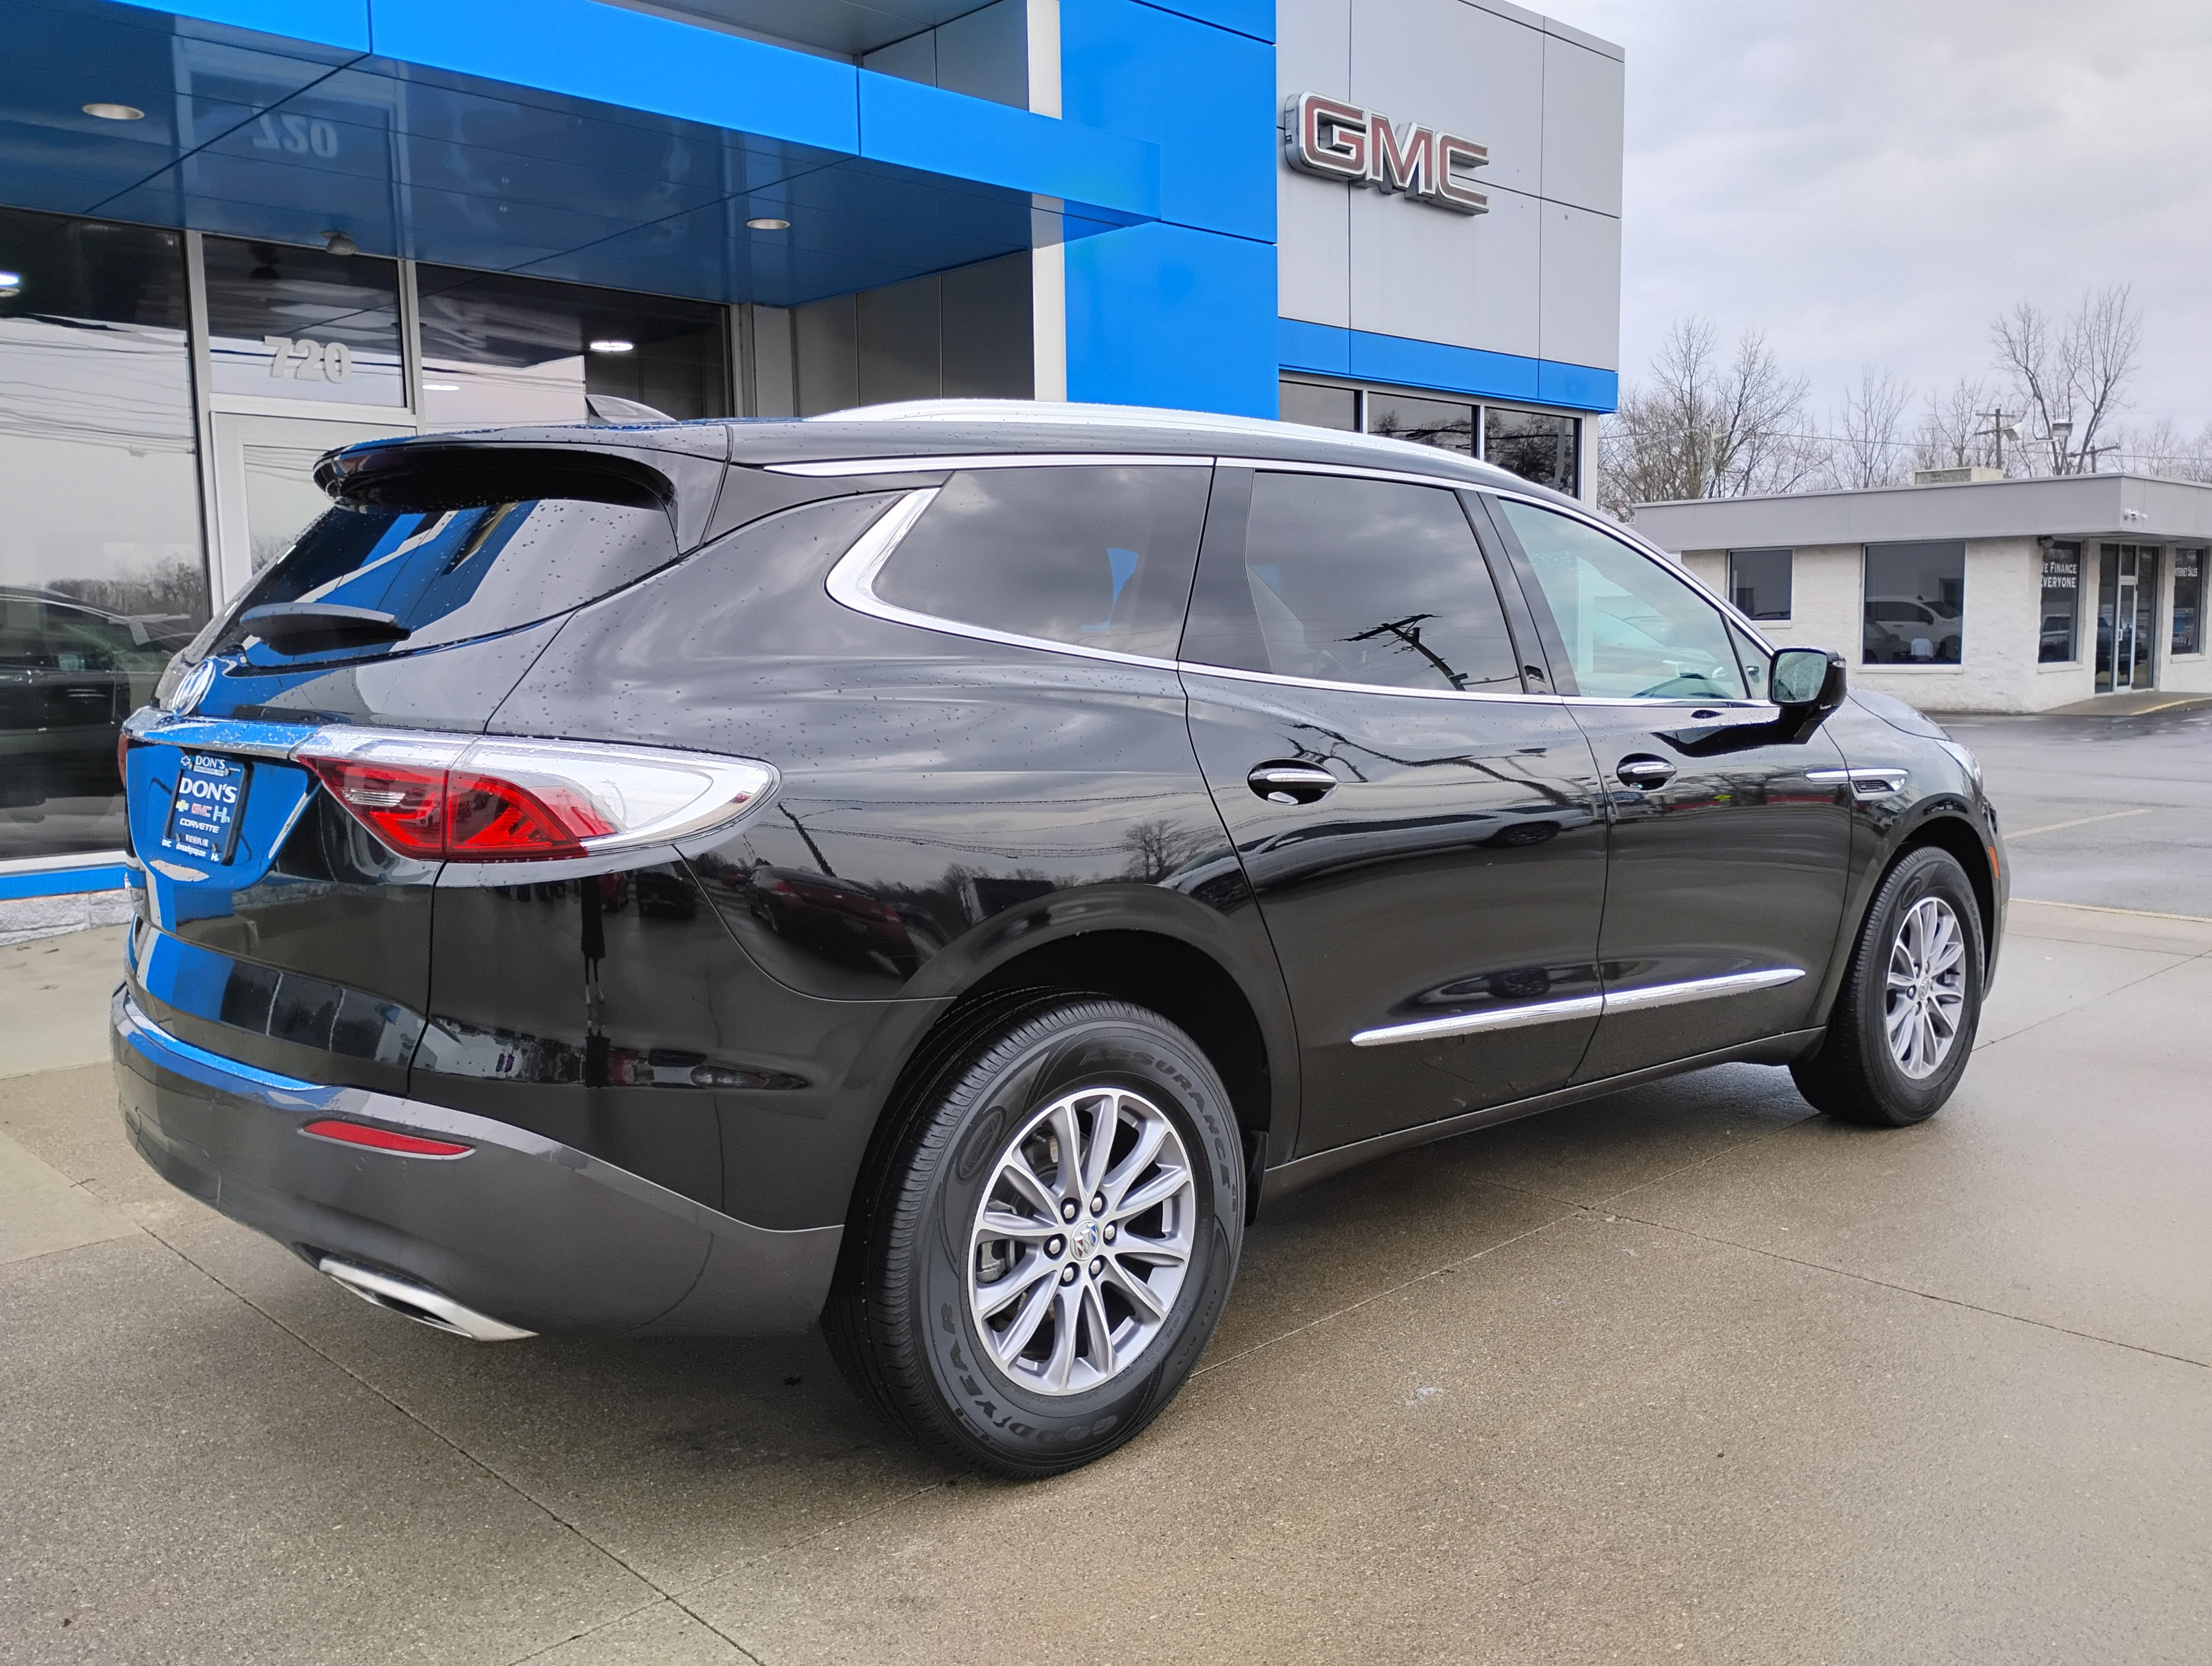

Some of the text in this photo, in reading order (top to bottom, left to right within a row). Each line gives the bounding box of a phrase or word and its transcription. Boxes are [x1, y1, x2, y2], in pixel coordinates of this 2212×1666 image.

[1297, 91, 1489, 209] GMC
[264, 335, 352, 383] 720
[2050, 561, 2077, 574] FINANCE
[195, 755, 226, 770] DON'S
[179, 777, 237, 803] DON'S
[191, 803, 212, 817] GMC
[179, 818, 221, 834] CORVETTE
[1079, 1048, 1230, 1189] ASSURANCE
